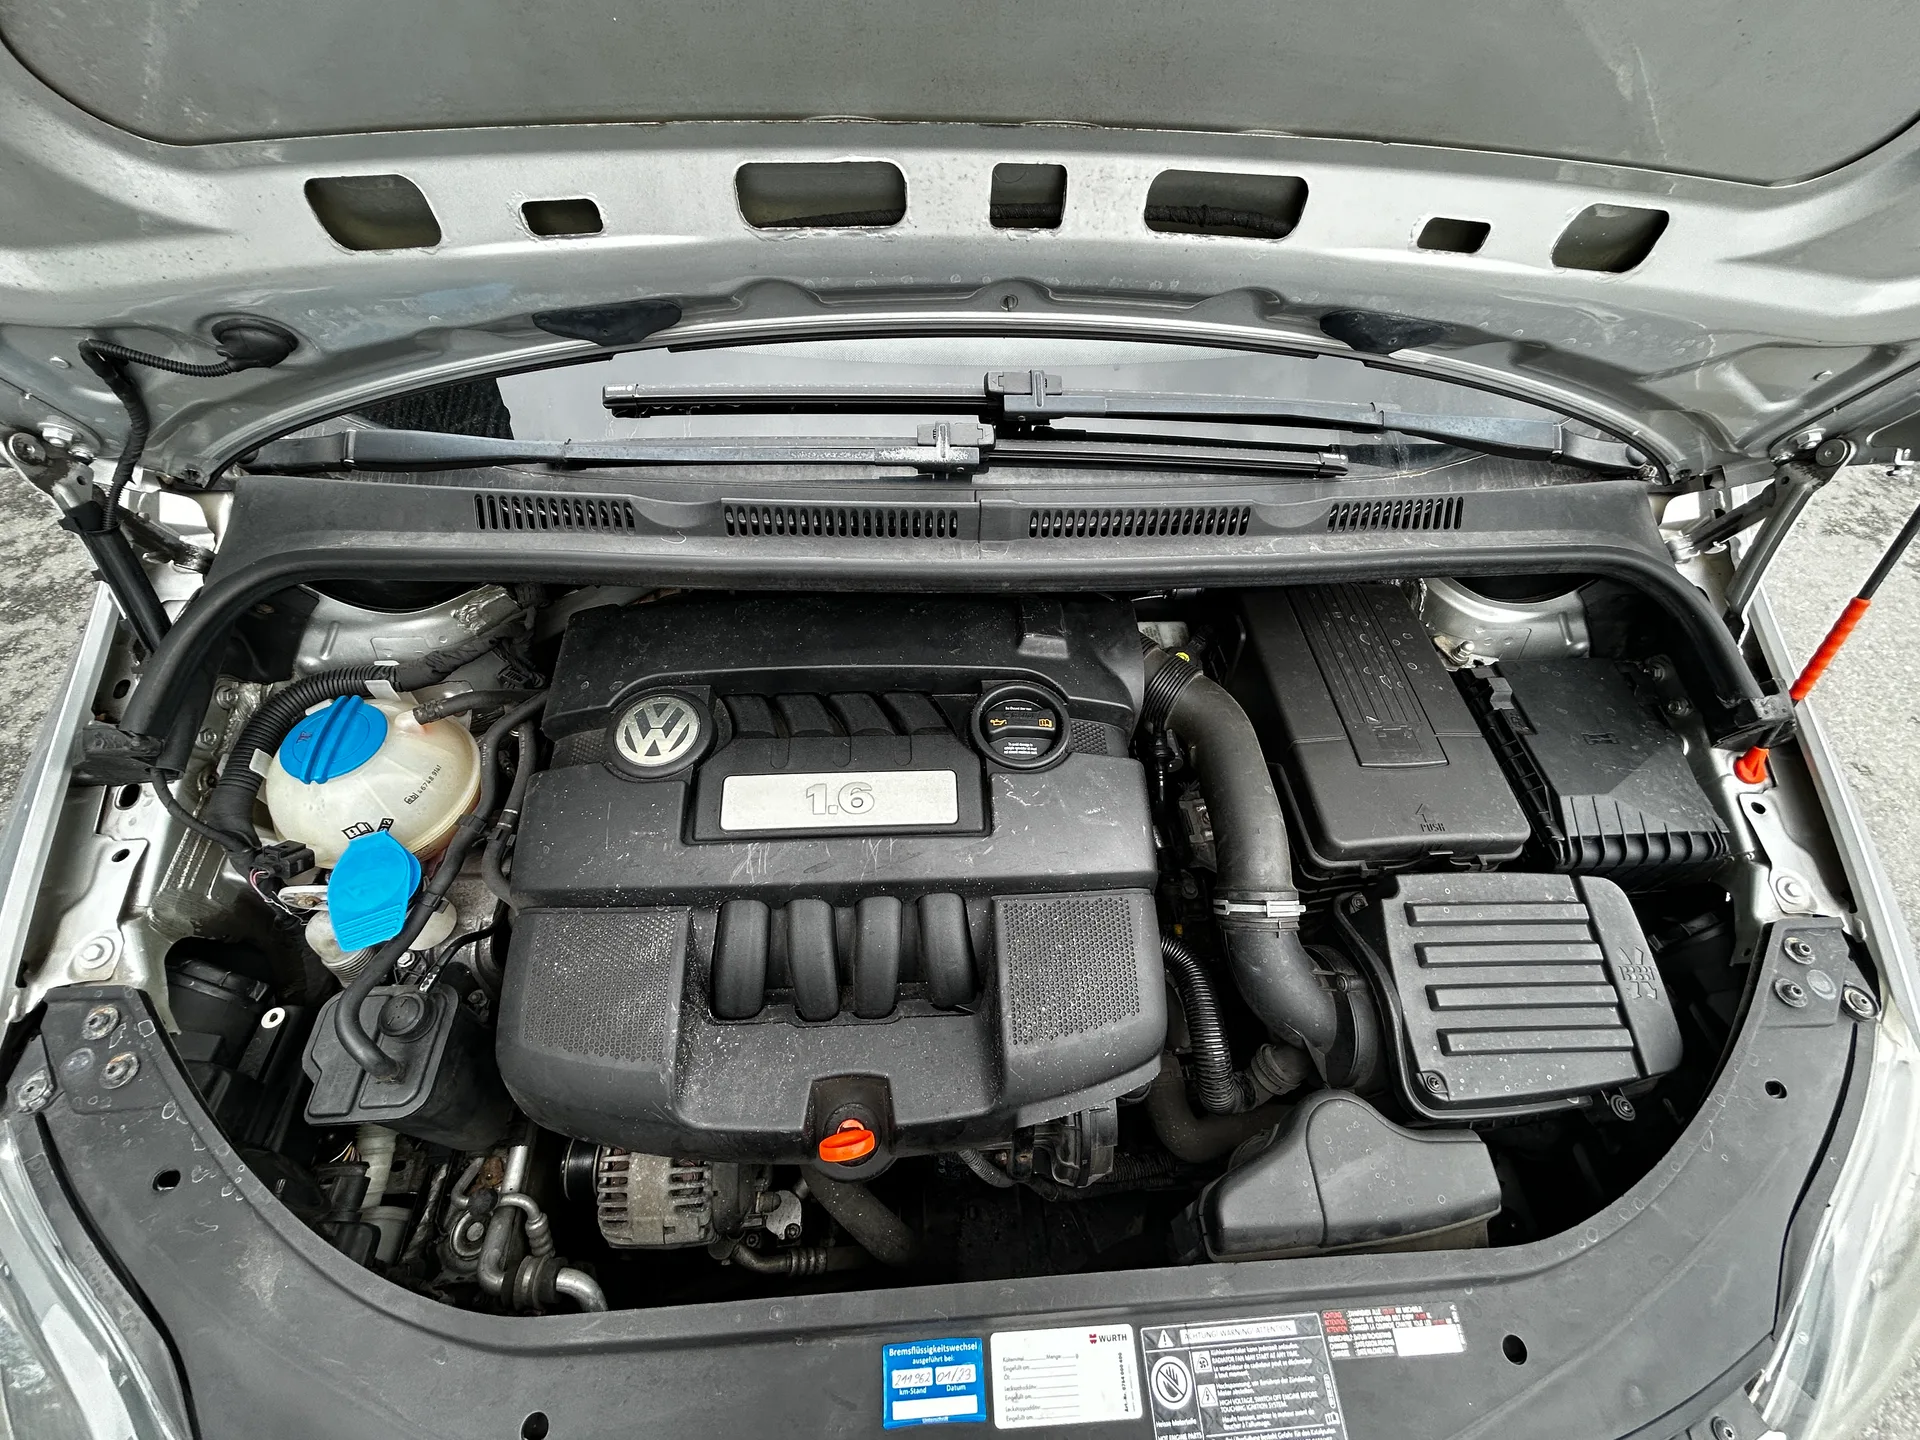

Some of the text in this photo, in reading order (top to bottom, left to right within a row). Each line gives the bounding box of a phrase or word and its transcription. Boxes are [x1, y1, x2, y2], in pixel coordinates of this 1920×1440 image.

[806, 782, 875, 816] 1.6
[1420, 822, 1446, 832] PUSH
[889, 1342, 978, 1357] Bremsflüssigkeitswechsel
[912, 1356, 943, 1365] ausgeführt
[899, 1387, 927, 1395] km-Stand
